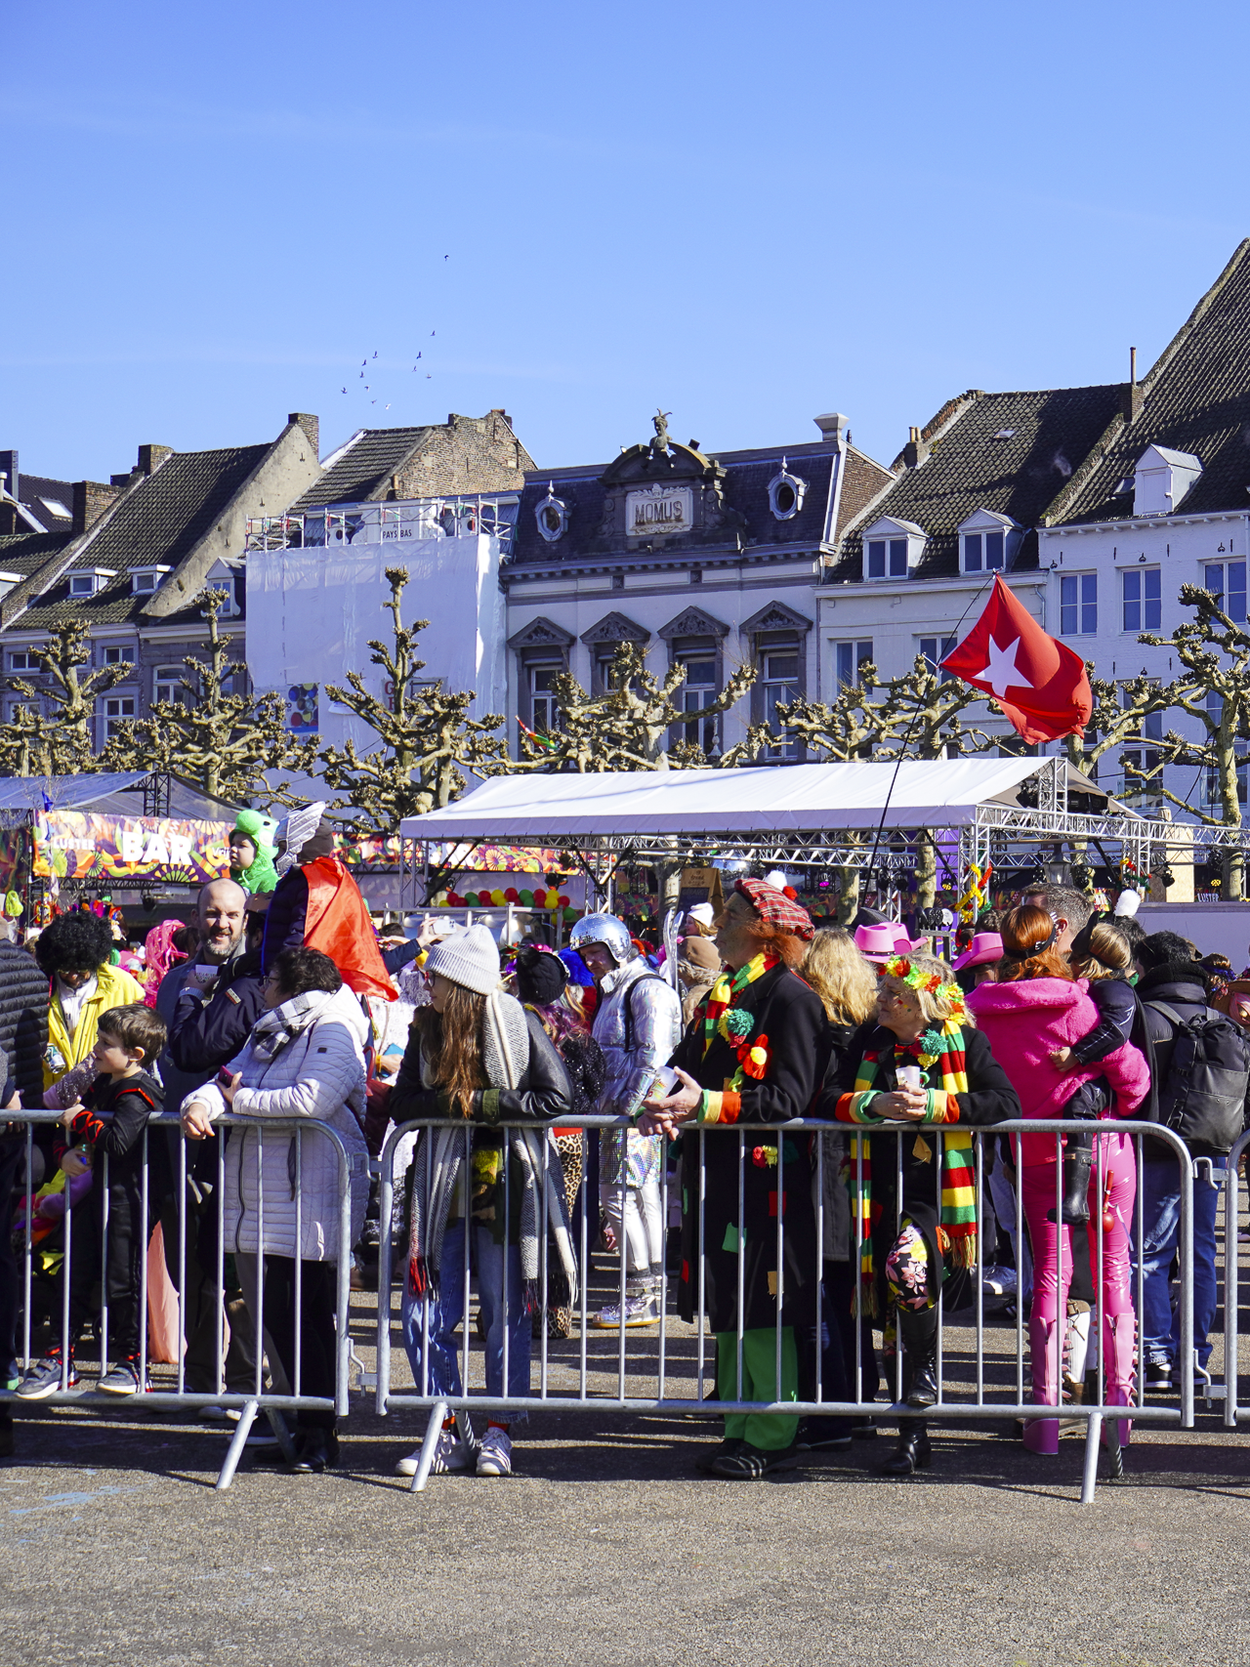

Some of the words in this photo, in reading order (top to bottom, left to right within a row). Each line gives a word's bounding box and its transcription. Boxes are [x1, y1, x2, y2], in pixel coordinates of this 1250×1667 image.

[635, 500, 684, 524] MOMUS
[383, 530, 398, 538] PAYS
[400, 529, 412, 538] BAS
[53, 838, 96, 851] LUSTER
[122, 831, 194, 866] BAR
[211, 846, 231, 860] Vrij
[1197, 892, 1220, 903] LUSTER
